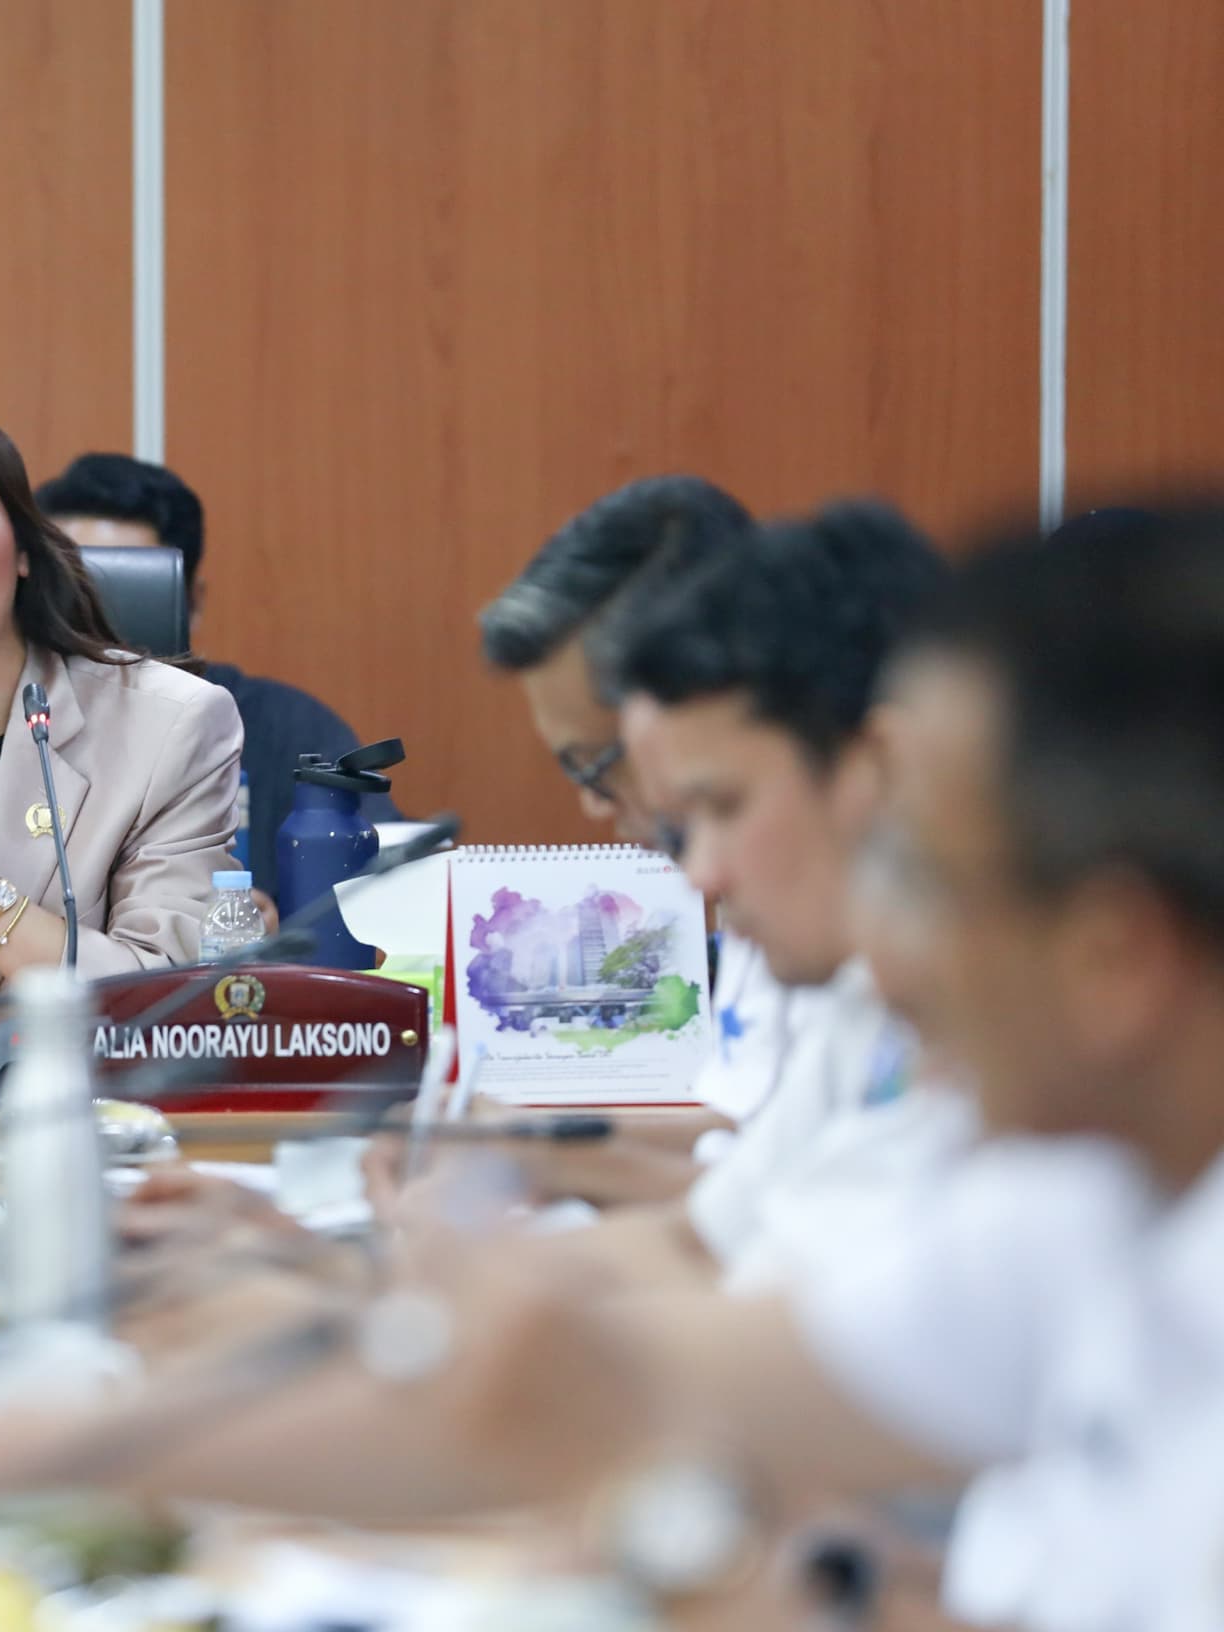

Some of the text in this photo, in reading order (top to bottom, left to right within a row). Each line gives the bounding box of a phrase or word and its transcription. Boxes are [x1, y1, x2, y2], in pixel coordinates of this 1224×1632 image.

[93, 1022, 391, 1059] ALIA NOORAYU LAKSONO
